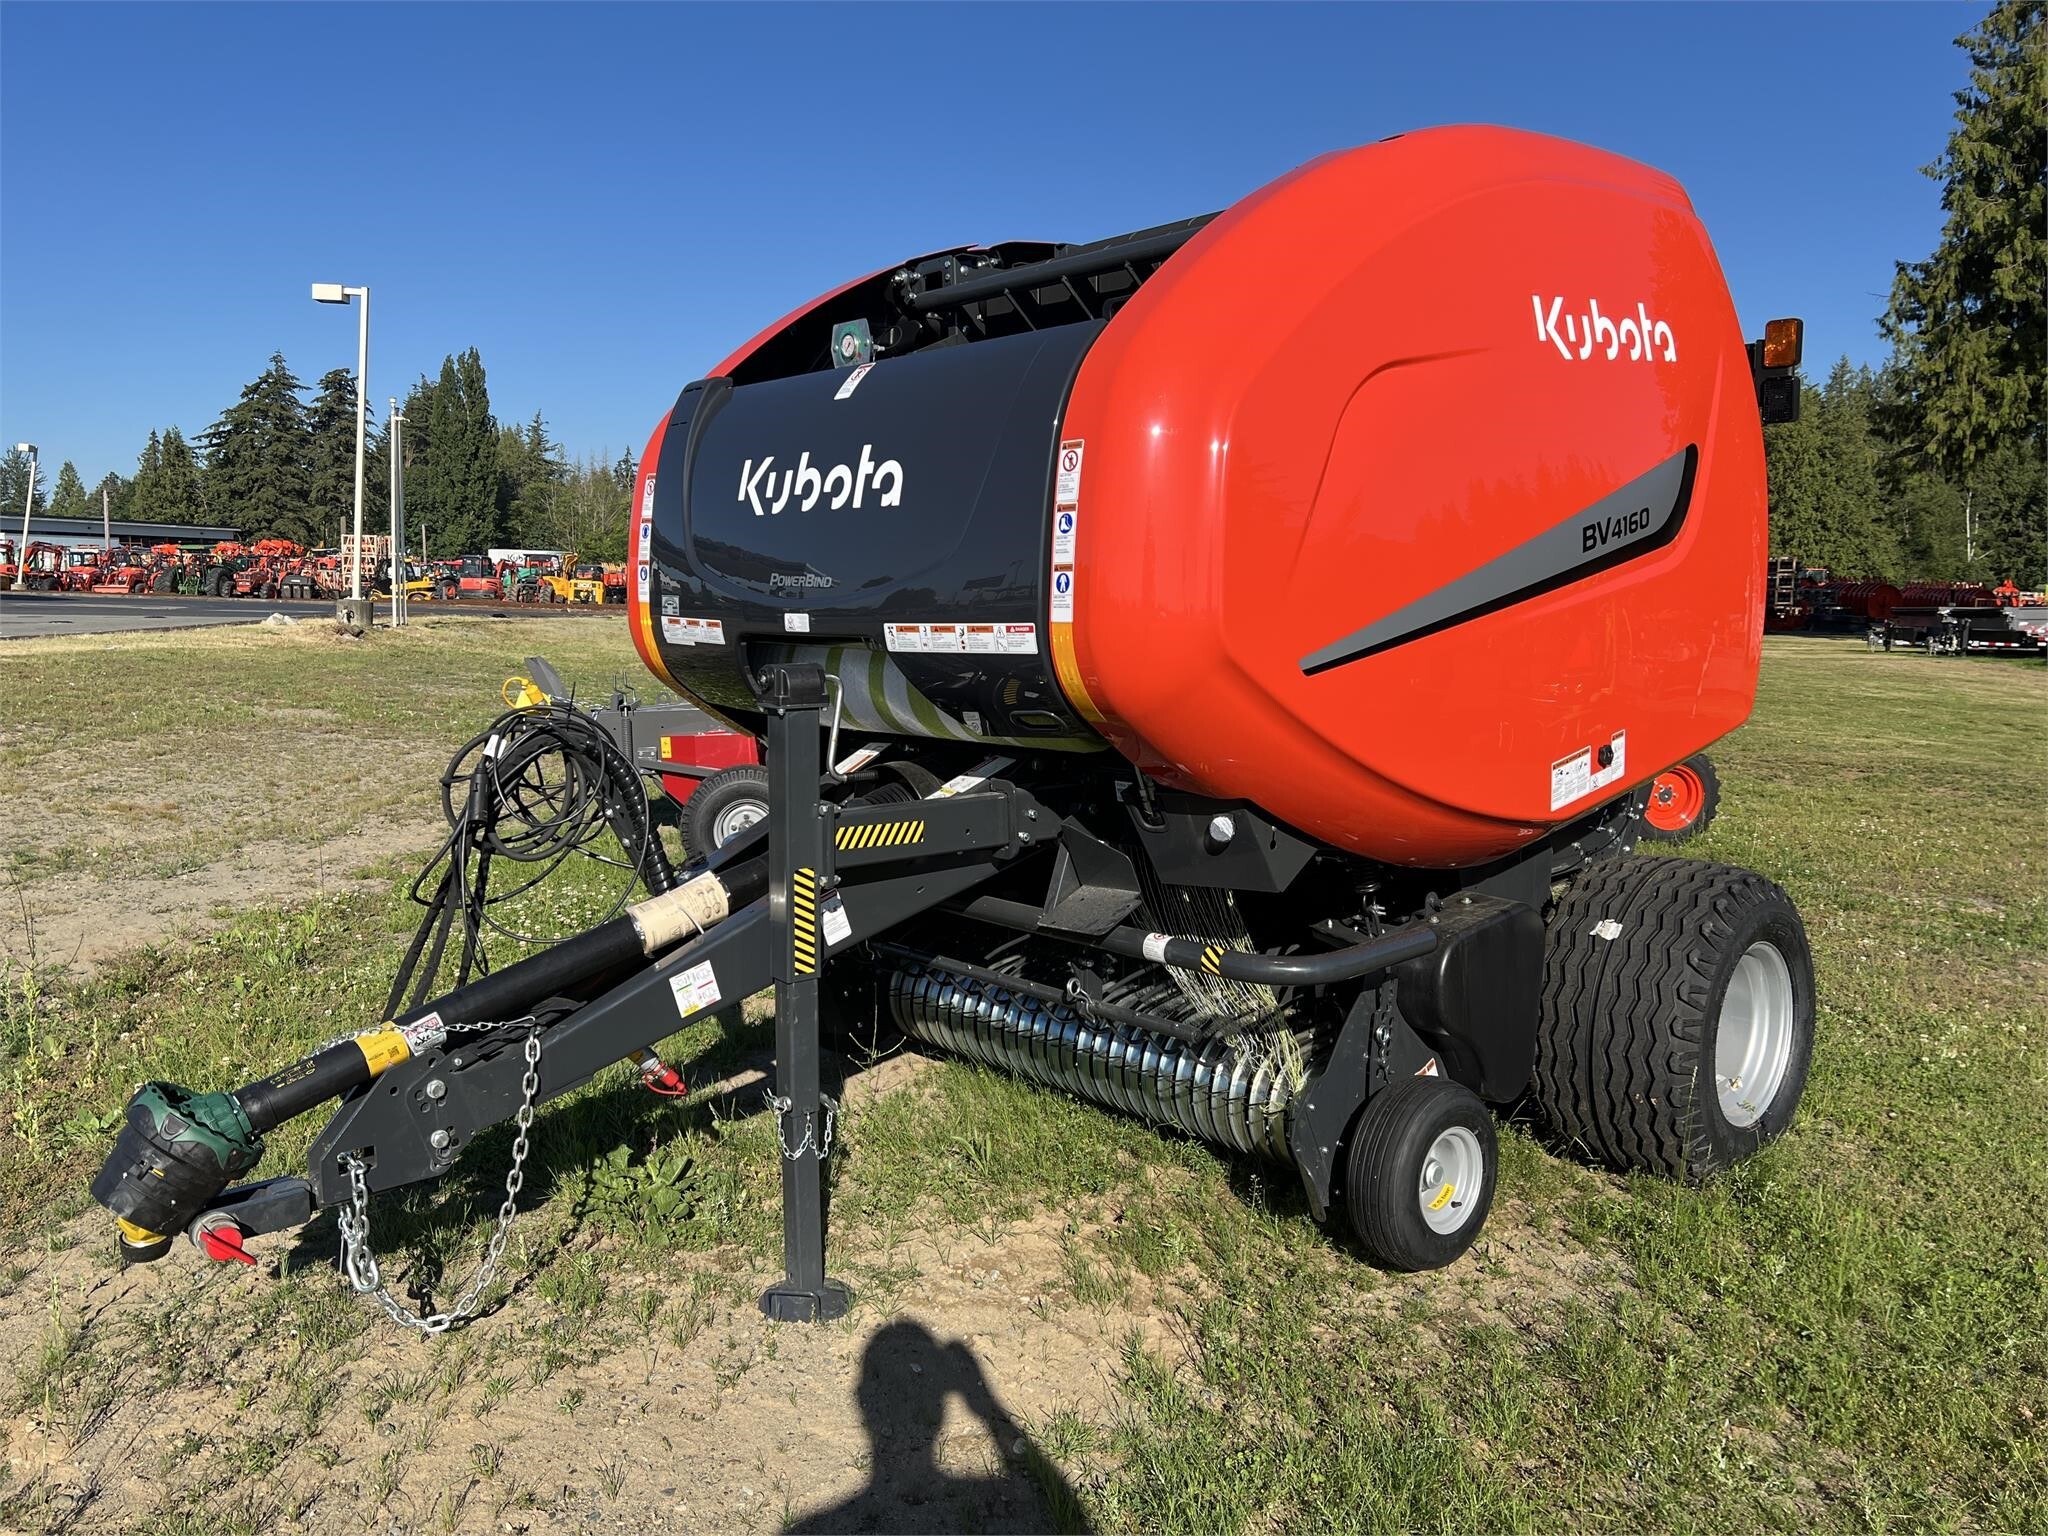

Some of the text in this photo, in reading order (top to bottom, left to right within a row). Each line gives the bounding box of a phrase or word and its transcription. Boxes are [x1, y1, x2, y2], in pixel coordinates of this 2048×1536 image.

[1532, 295, 1677, 362] Kubota
[738, 444, 903, 516] Kubota
[1582, 507, 1649, 553] BV4160
